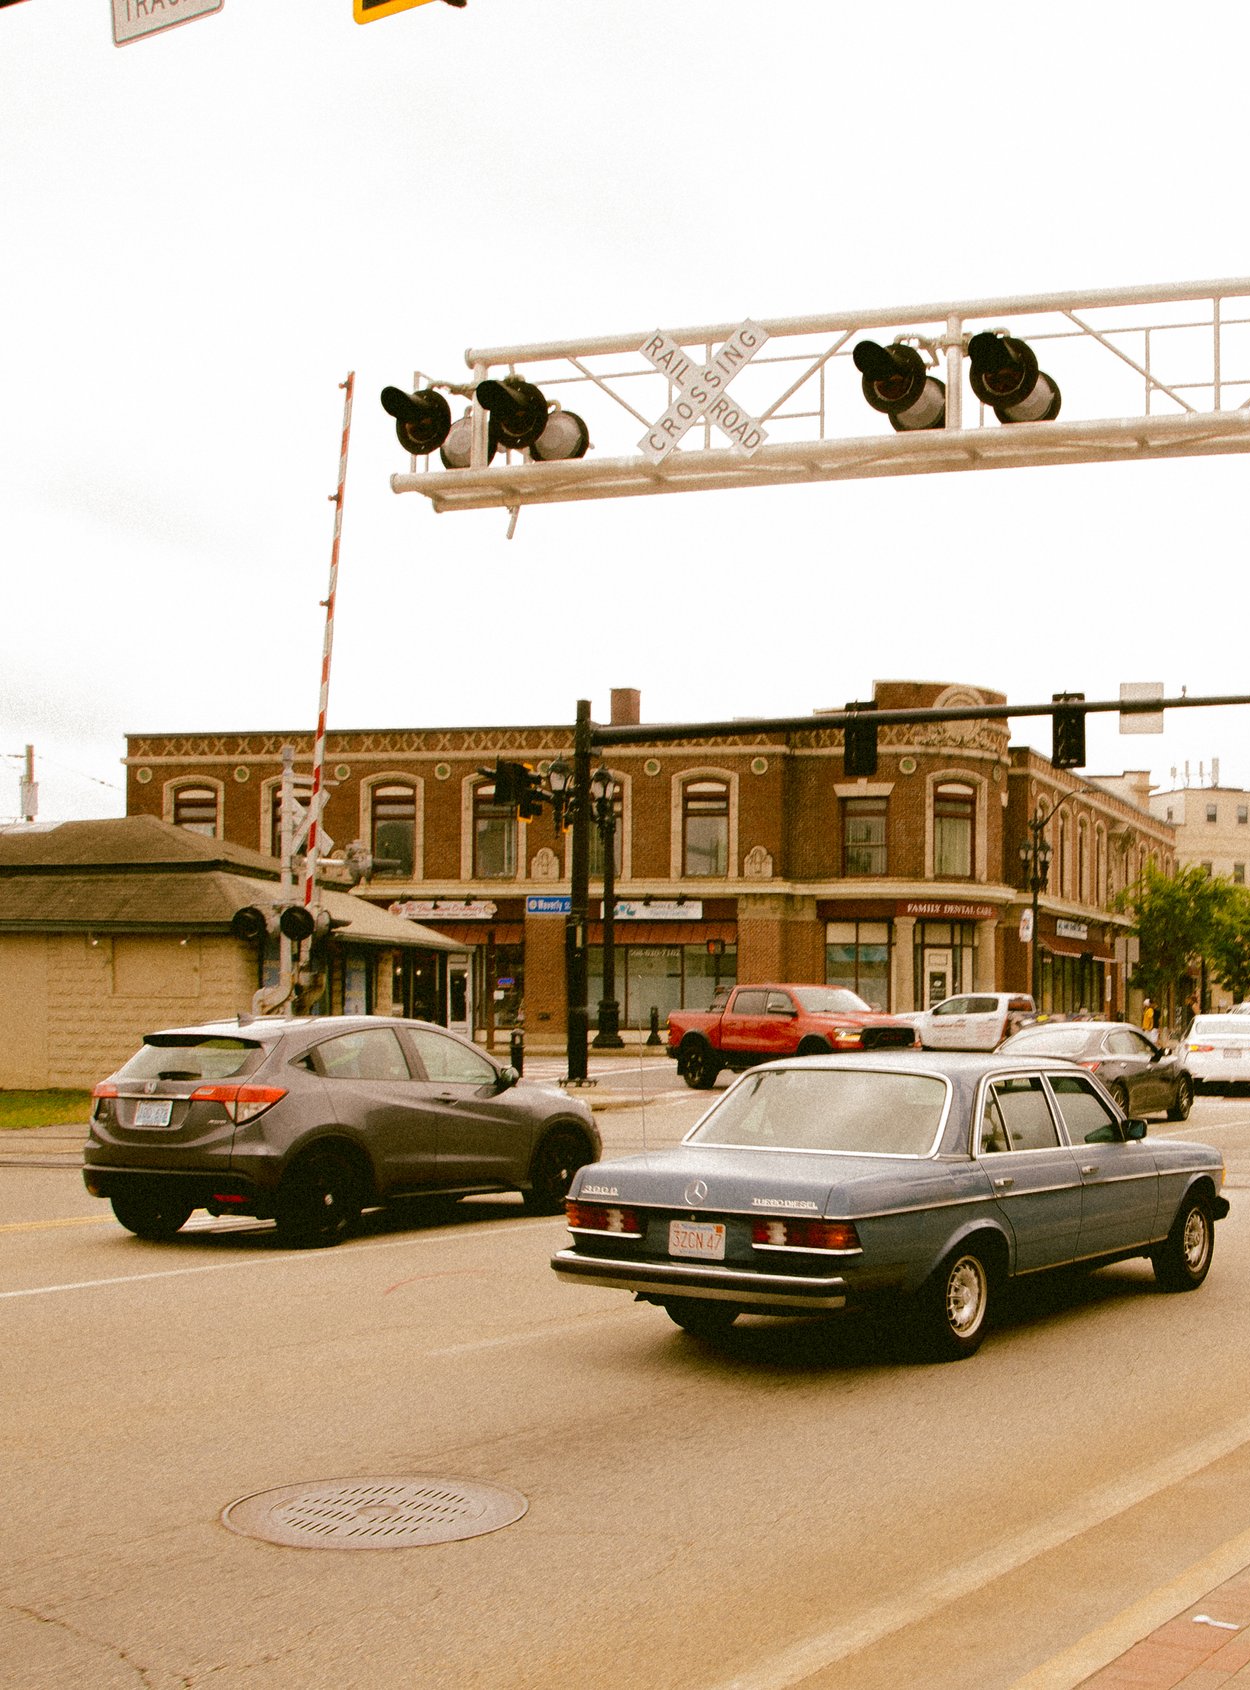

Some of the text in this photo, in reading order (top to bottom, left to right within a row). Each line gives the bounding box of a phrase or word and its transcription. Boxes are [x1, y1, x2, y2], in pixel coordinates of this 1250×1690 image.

[645, 335, 689, 385] RAIL
[649, 331, 756, 451] CROSSING
[710, 398, 761, 449] ROAD
[907, 903, 941, 913] FAMILY
[943, 904, 976, 914] DENTAL
